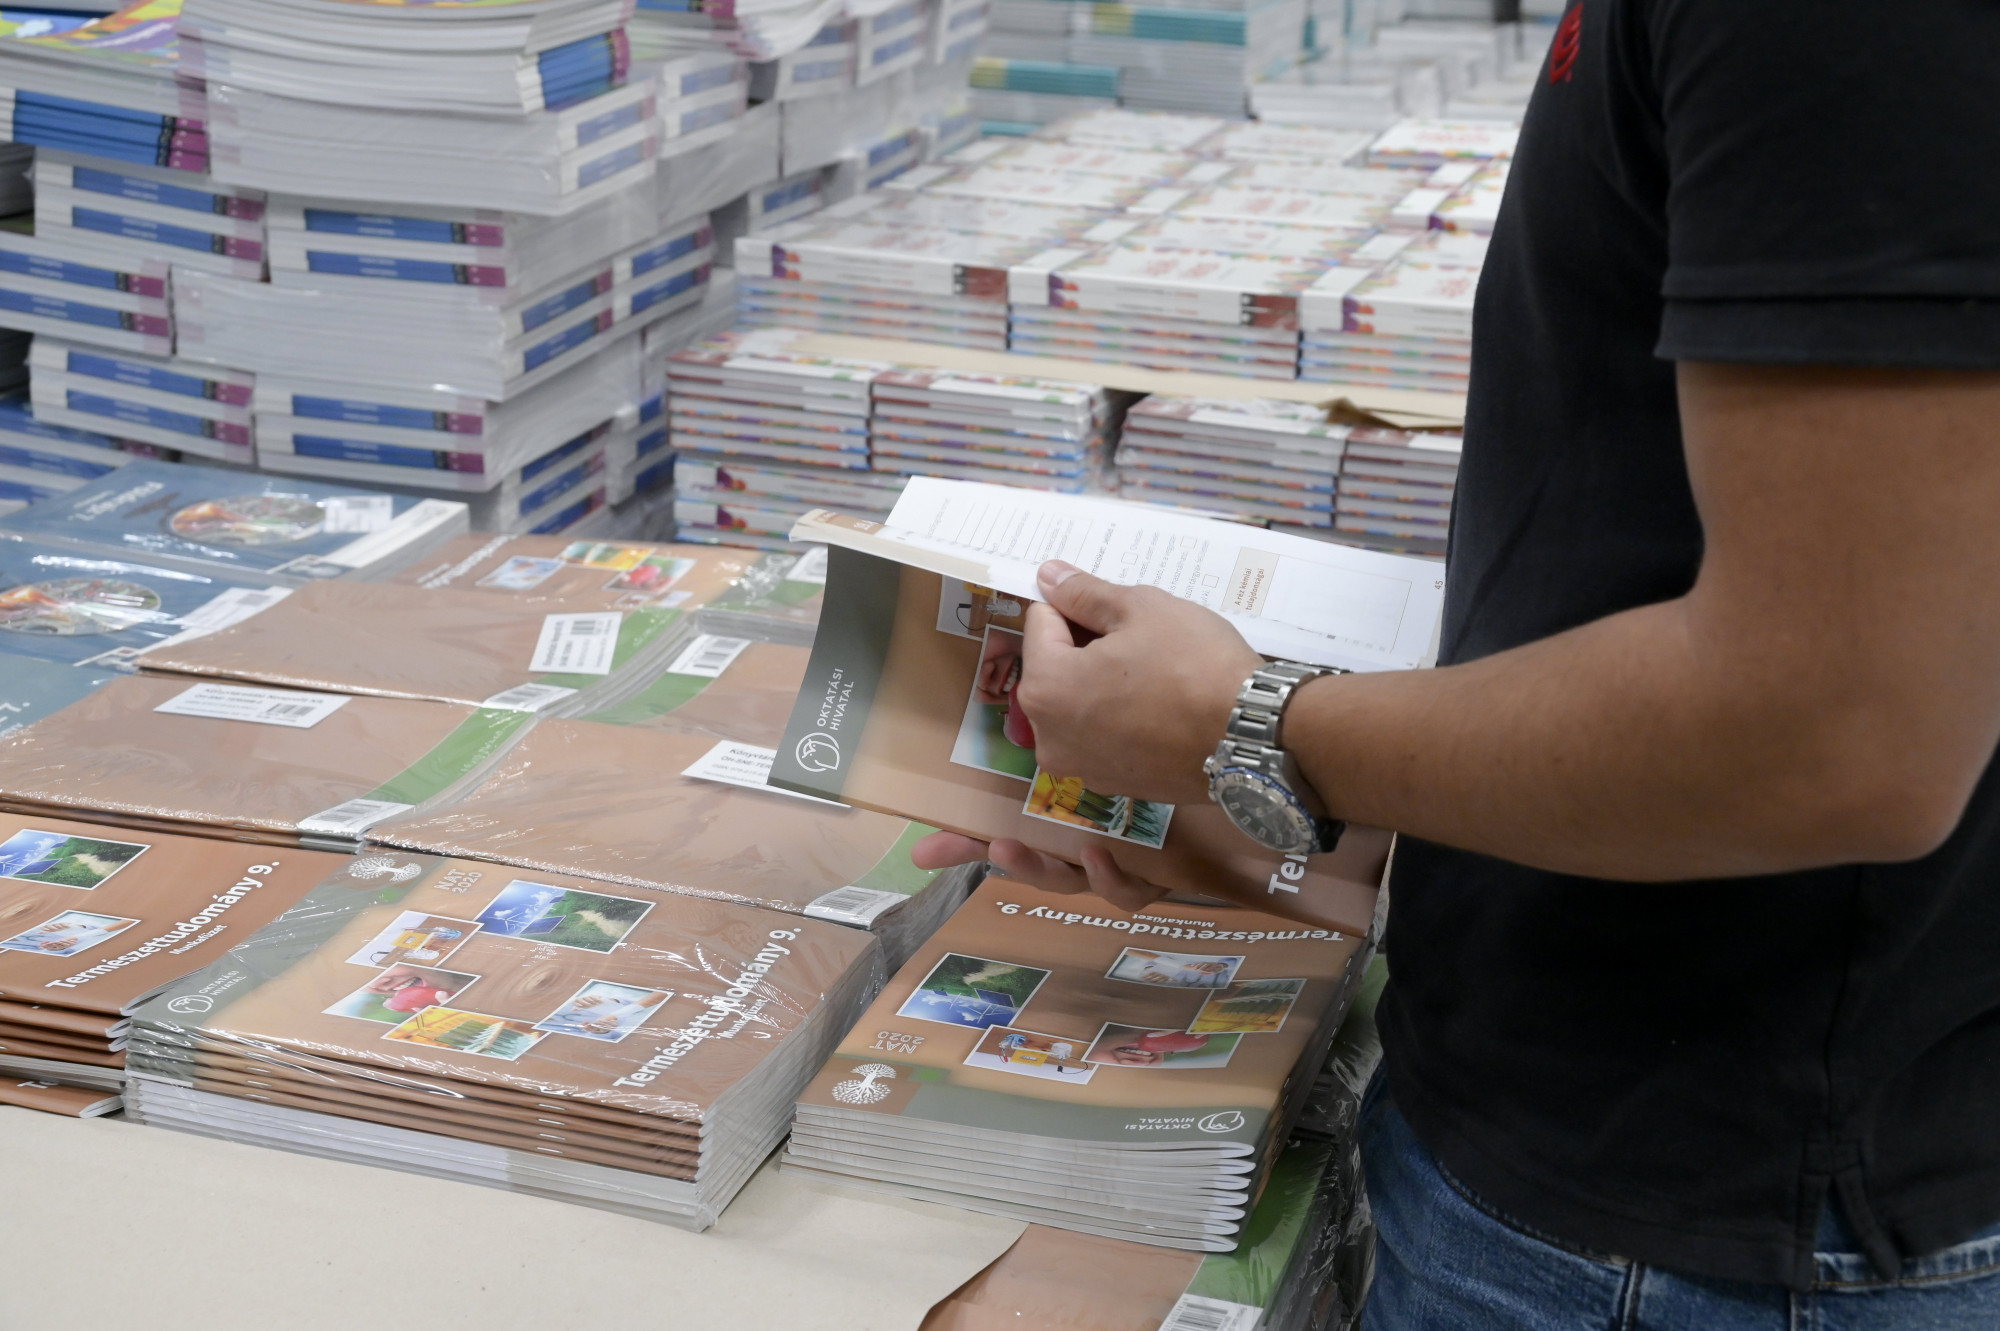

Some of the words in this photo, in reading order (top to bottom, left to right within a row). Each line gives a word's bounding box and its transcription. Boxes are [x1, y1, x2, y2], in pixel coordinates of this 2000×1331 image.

[1239, 567, 1253, 590] kémiai
[1245, 567, 1265, 611] tulajdonságai
[1434, 579, 1444, 591] 45
[1237, 589, 1245, 601] réz
[816, 667, 844, 727] OKTATÁSI
[829, 681, 855, 731] HIVATAL
[433, 868, 467, 891] NAT
[451, 871, 483, 894] 2020
[995, 901, 1021, 915] 9.
[45, 876, 263, 989] Természettudomány
[247, 860, 281, 877] 9.
[1025, 906, 1344, 945] Természettudomány
[1131, 913, 1216, 928] Munkafüzet
[168, 924, 228, 955] Munkafüzet
[198, 970, 240, 994] OKTATÁSI
[209, 975, 247, 996] HIVATAL
[612, 941, 791, 1088] Természettudomány
[769, 927, 802, 941] 9.
[868, 1039, 917, 1054] NAT
[877, 1030, 925, 1045] 2020
[1124, 1123, 1192, 1131] OKTATÁSI
